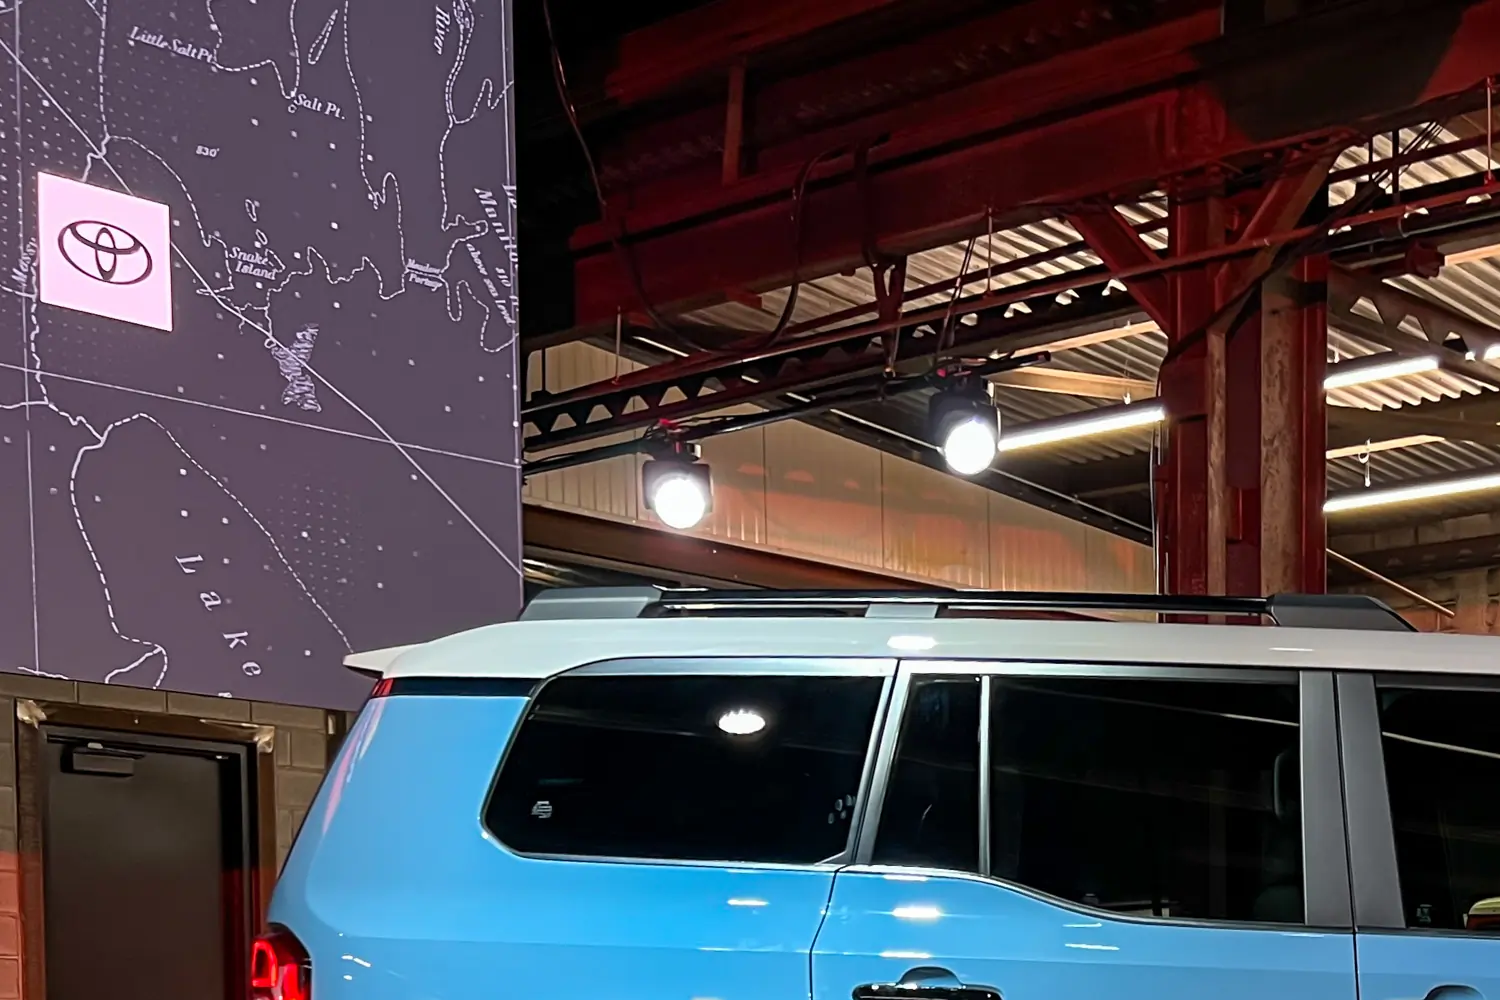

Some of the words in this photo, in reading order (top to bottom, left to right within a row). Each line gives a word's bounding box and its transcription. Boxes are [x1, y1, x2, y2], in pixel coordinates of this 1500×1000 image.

[433, 5, 451, 55] River
[171, 38, 198, 60] Salt
[294, 93, 323, 113] Salt
[324, 101, 346, 120] Pt.
[229, 246, 268, 266] Snake
[235, 260, 276, 280] Island
